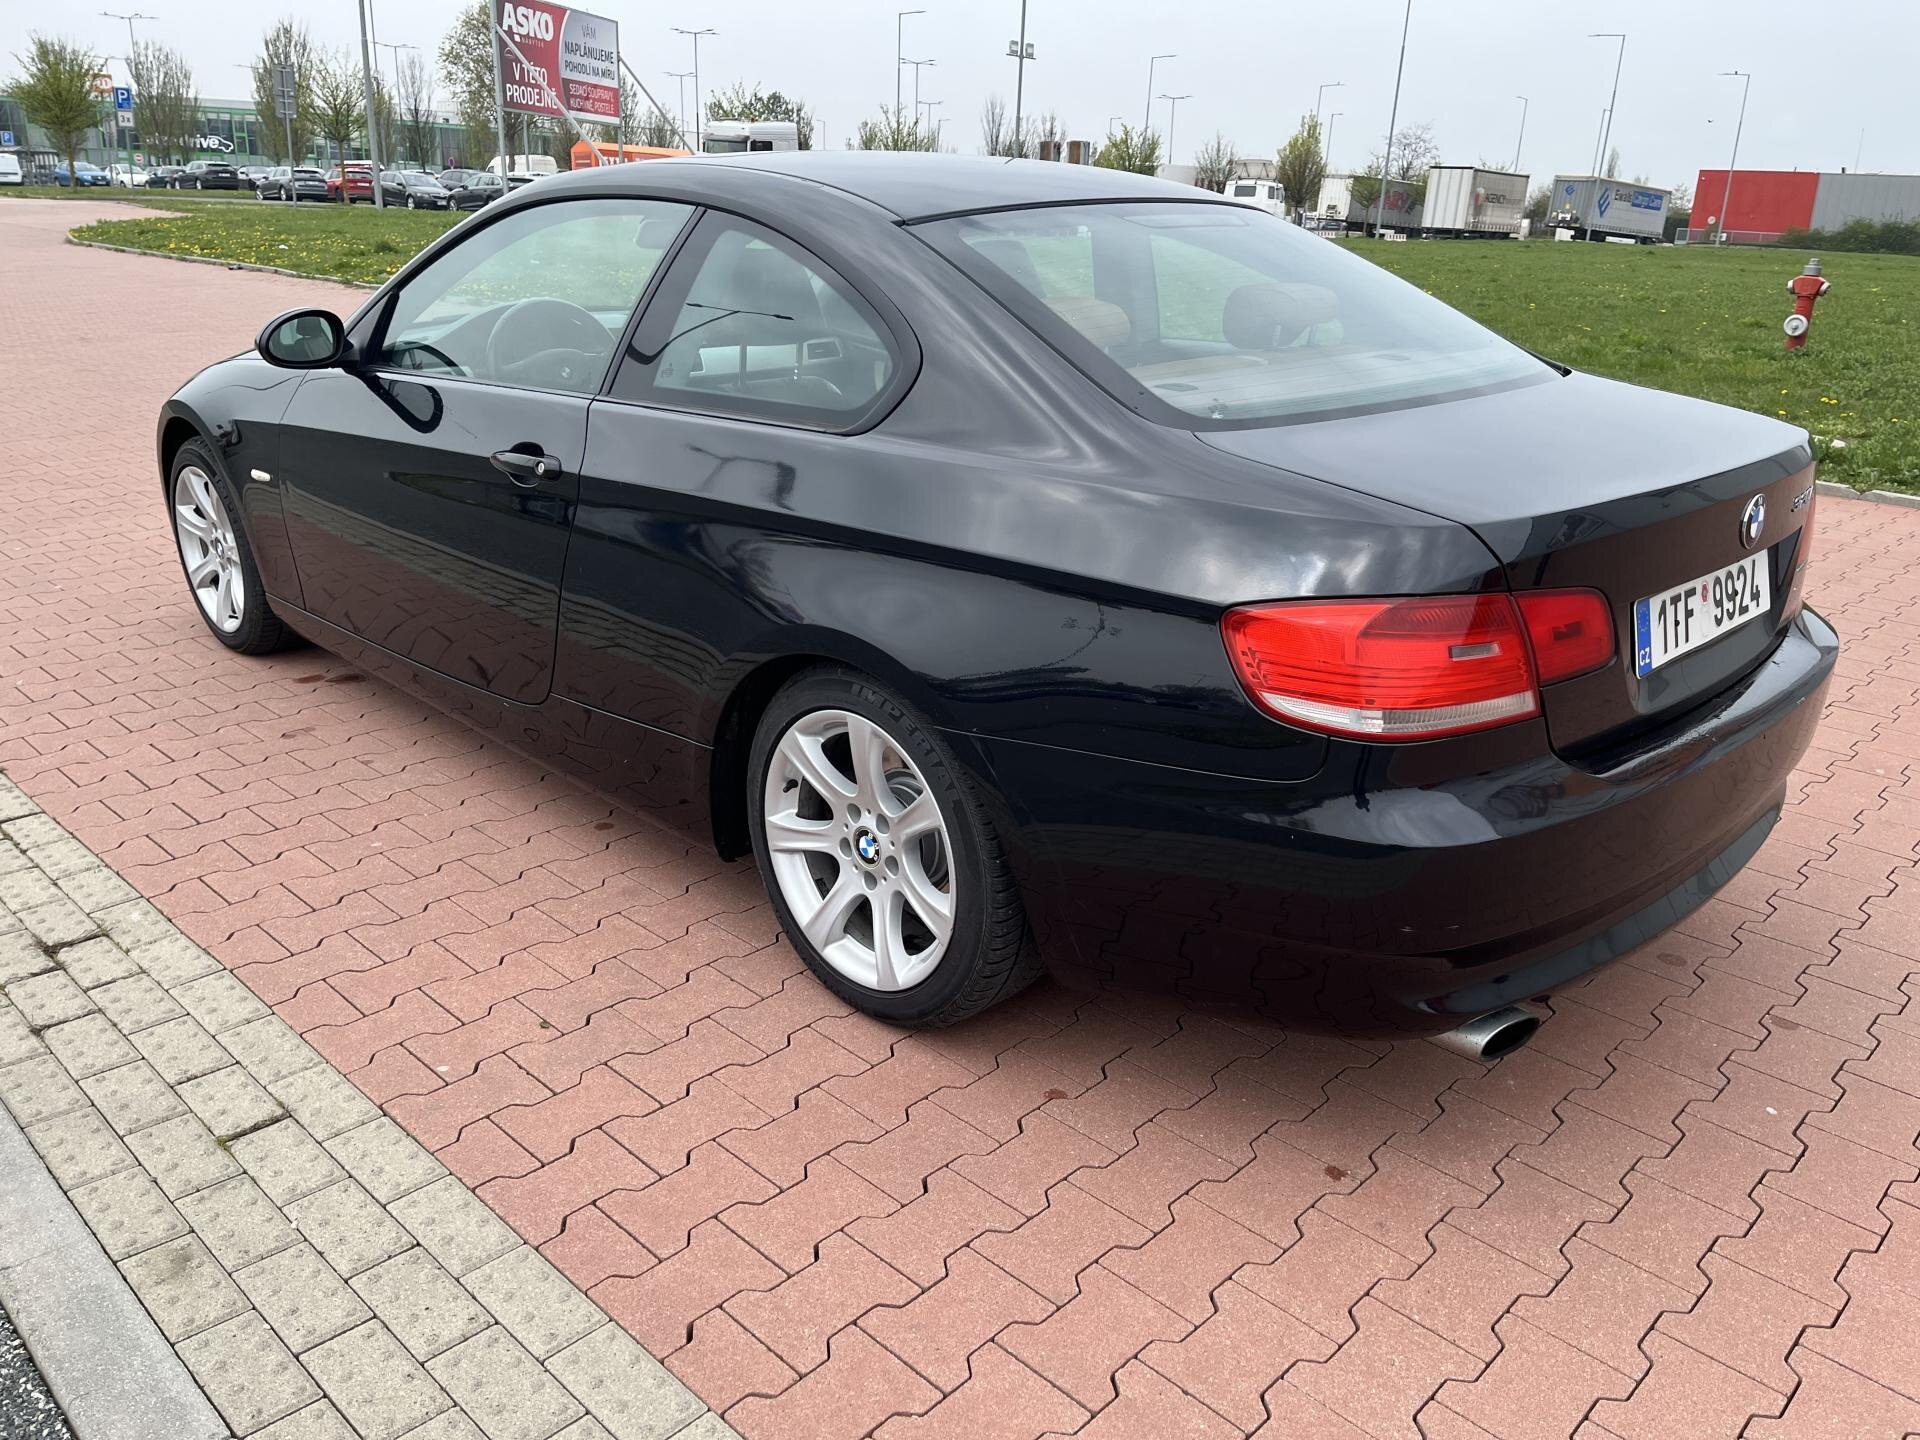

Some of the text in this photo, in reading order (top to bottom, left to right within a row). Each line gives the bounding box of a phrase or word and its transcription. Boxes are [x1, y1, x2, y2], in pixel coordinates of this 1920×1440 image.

[503, 2, 554, 41] ASKO
[582, 23, 597, 40] VÁM
[564, 41, 614, 65] NAPLÁNUJEME
[512, 61, 548, 85] V TÉTO
[564, 60, 615, 81] POHODLÍ NA MÍRU
[117, 89, 128, 103] P
[506, 84, 558, 109] PRODEJNĚ
[1657, 559, 1761, 655] 1TF 9924
[1639, 646, 1651, 666] CZ
